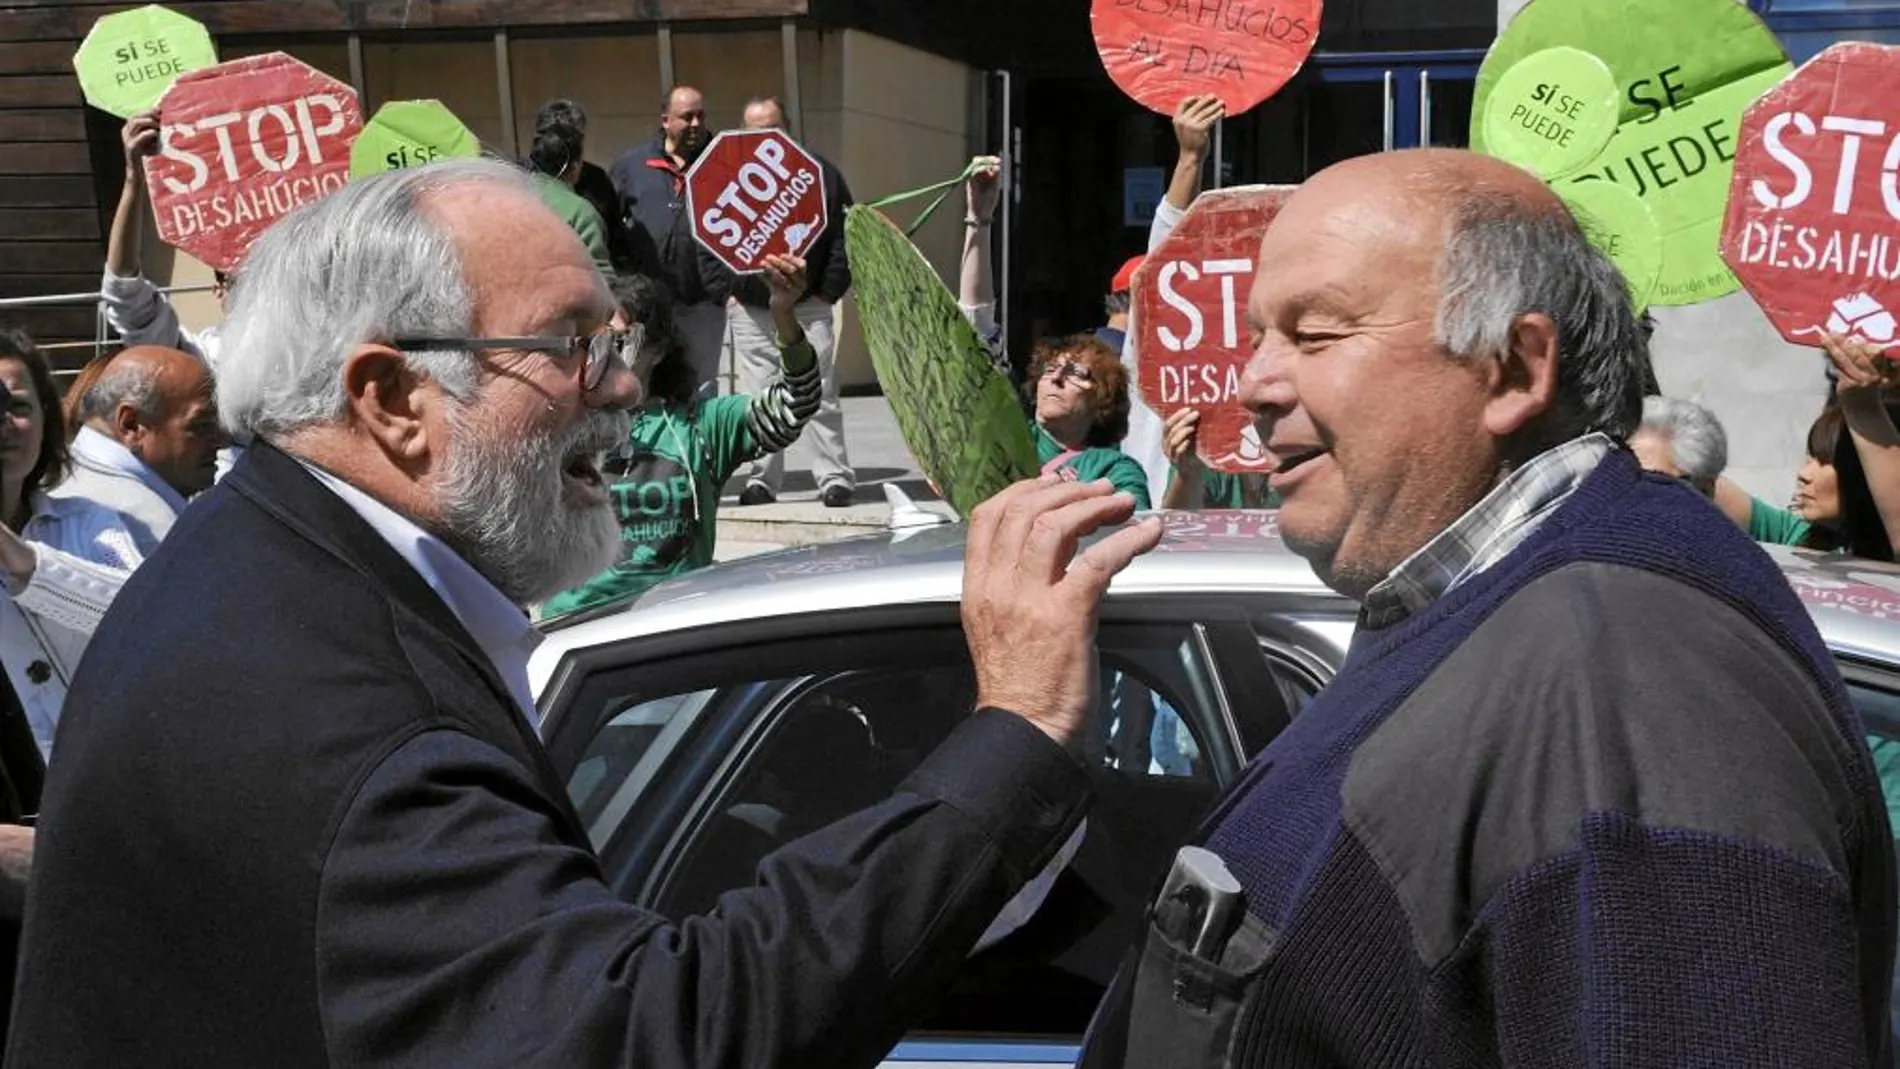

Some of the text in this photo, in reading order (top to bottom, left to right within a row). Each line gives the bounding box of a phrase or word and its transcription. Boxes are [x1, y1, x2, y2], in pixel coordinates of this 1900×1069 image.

[1116, 0, 1309, 44] AHUCIOS
[144, 38, 171, 55] SE
[1128, 35, 1166, 67] AL
[115, 57, 188, 86] PUEDE
[1555, 95, 1585, 121] SE
[1627, 65, 1694, 124] SE
[160, 93, 345, 194] STOP
[1510, 104, 1575, 148] PUEDE
[1572, 119, 1735, 196] UEDE
[172, 170, 349, 237] DESAHUCIO
[702, 138, 791, 247] STOP
[734, 168, 815, 265] DESAHUCIOS
[1157, 258, 1252, 351] ST
[1160, 363, 1247, 404] DESA
[610, 475, 694, 518] TOP
